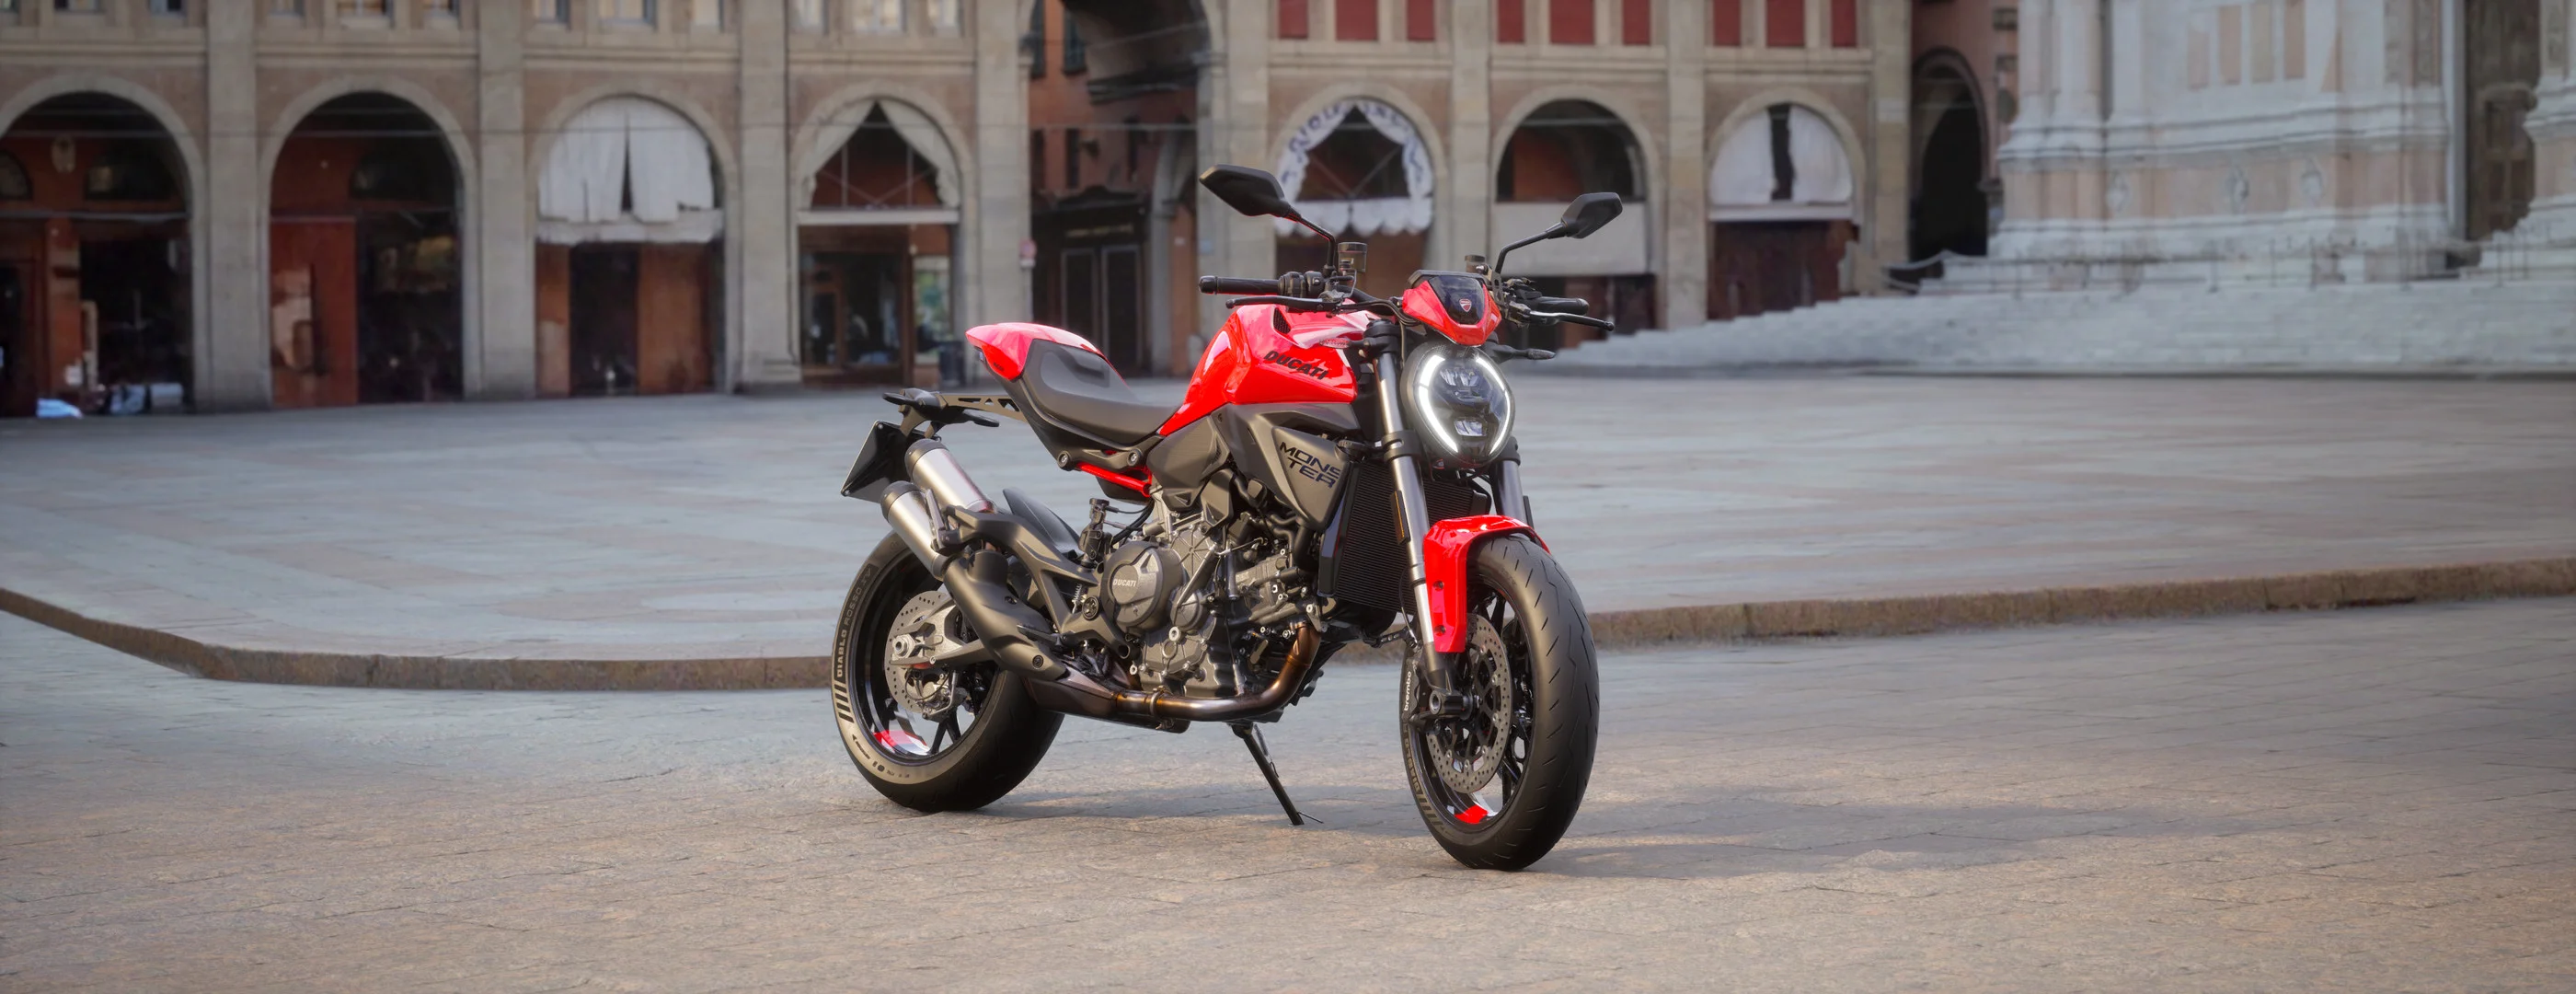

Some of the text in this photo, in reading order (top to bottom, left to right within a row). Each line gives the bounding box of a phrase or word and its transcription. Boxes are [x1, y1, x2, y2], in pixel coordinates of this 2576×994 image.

[1263, 350, 1328, 380] DUCATI
[1279, 441, 1341, 479] MONS
[1287, 457, 1336, 489] TER
[1112, 577, 1137, 587] DUCATI
[836, 629, 847, 678] DIABLO
[844, 587, 862, 626] ROSSO
